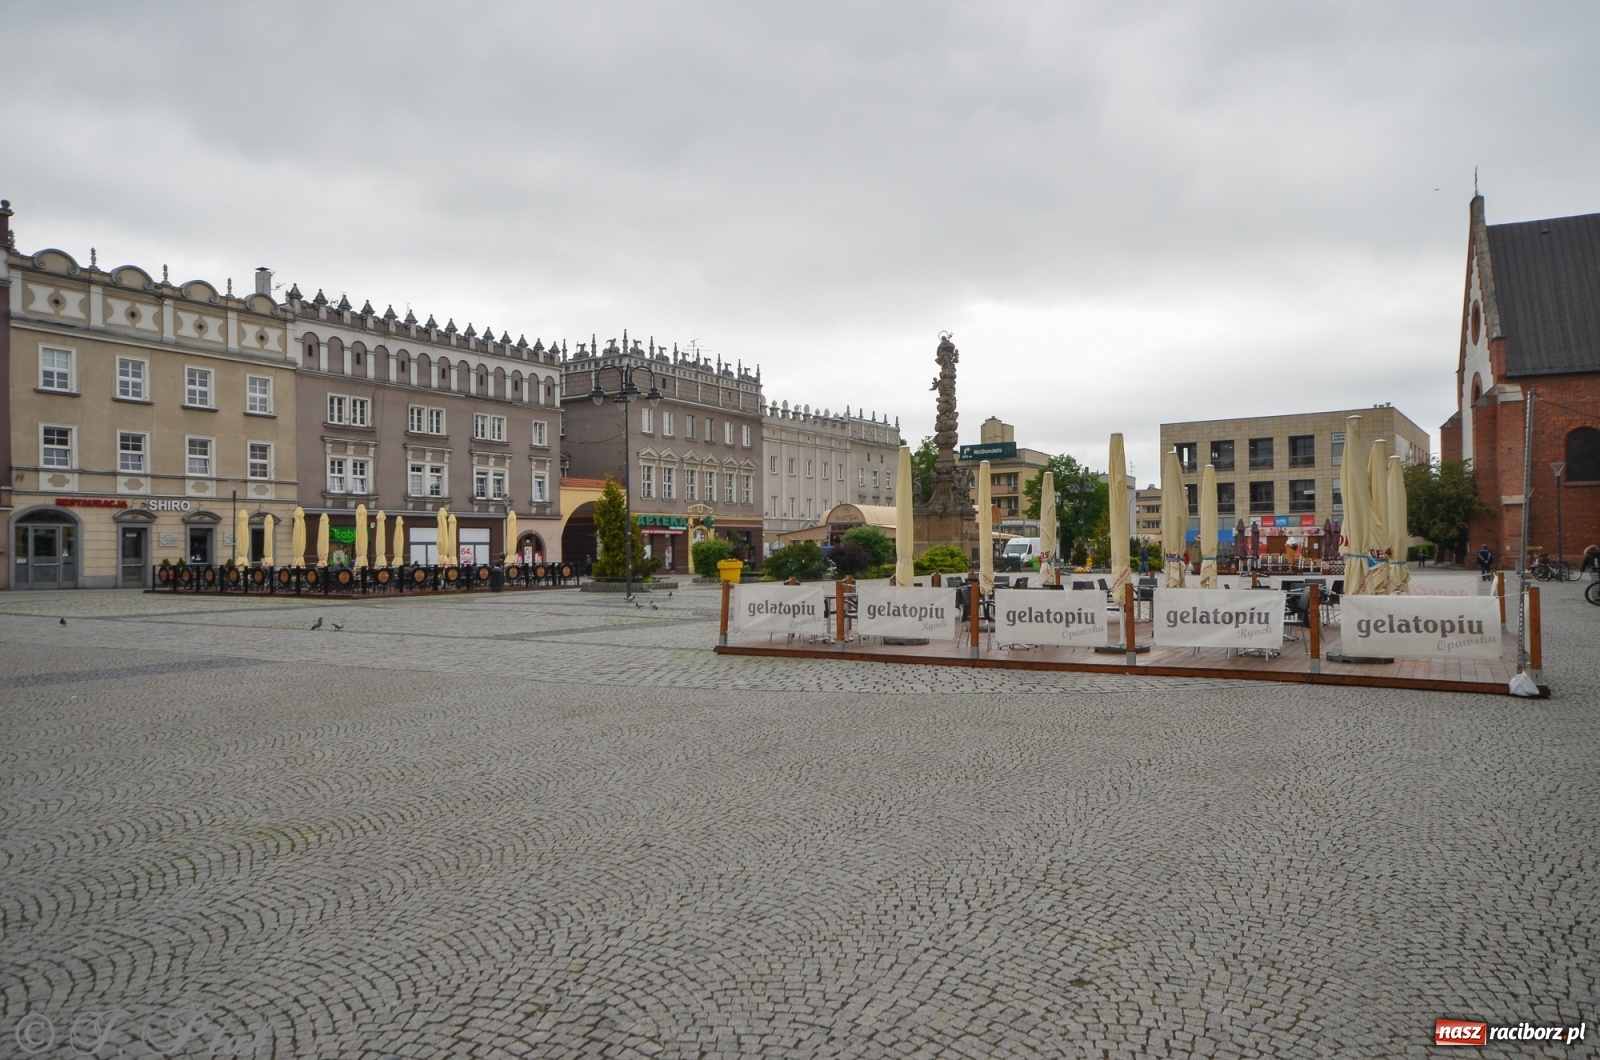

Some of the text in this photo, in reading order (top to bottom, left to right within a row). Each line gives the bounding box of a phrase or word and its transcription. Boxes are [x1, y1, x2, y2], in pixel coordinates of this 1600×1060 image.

[55, 498, 128, 509] RESTAURACJA
[149, 500, 191, 511] SHIRO
[636, 515, 687, 527] APTEKA
[748, 600, 815, 618] gelatopiu
[867, 601, 945, 622] gelatopiu
[789, 616, 822, 629] Opawska
[1006, 607, 1095, 628] gelatopiu
[1166, 607, 1270, 629] gelatopiu
[921, 620, 947, 632] Rynek
[1062, 625, 1104, 640] Opawska
[1237, 625, 1273, 639] Rynek
[1357, 614, 1484, 638] gelatopiu
[1437, 634, 1498, 652] Opawska
